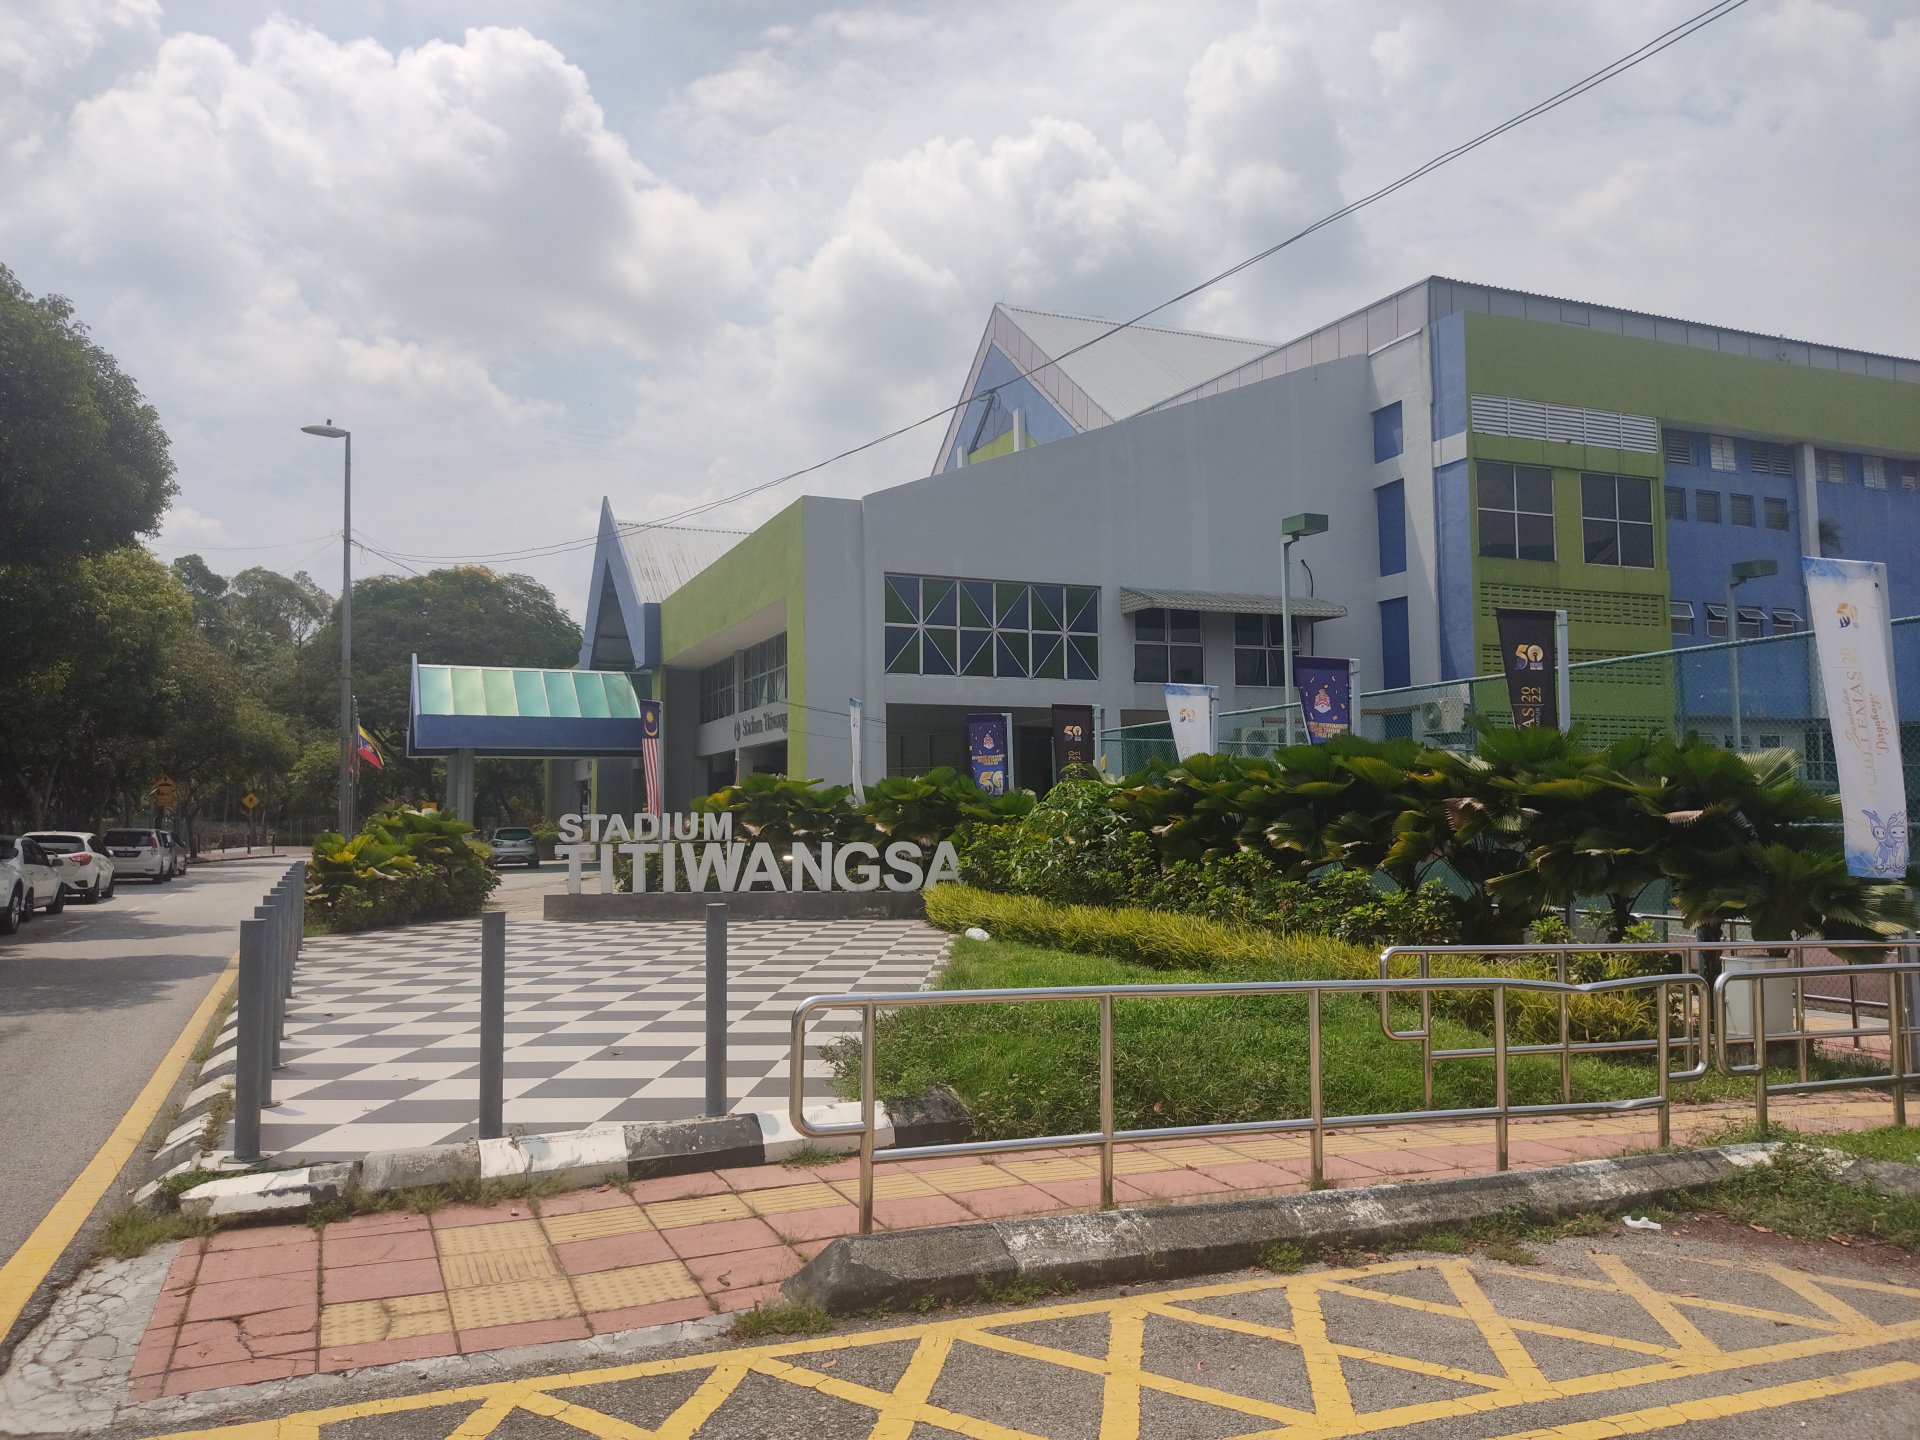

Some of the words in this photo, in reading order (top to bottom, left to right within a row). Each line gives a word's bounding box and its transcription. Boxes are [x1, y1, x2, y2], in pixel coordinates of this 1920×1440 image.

[1514, 645, 1543, 670] 50
[1521, 686, 1530, 703] 20
[1531, 686, 1542, 703] 22
[558, 812, 733, 843] STADIUM
[554, 840, 960, 895] TITIWANGSA
